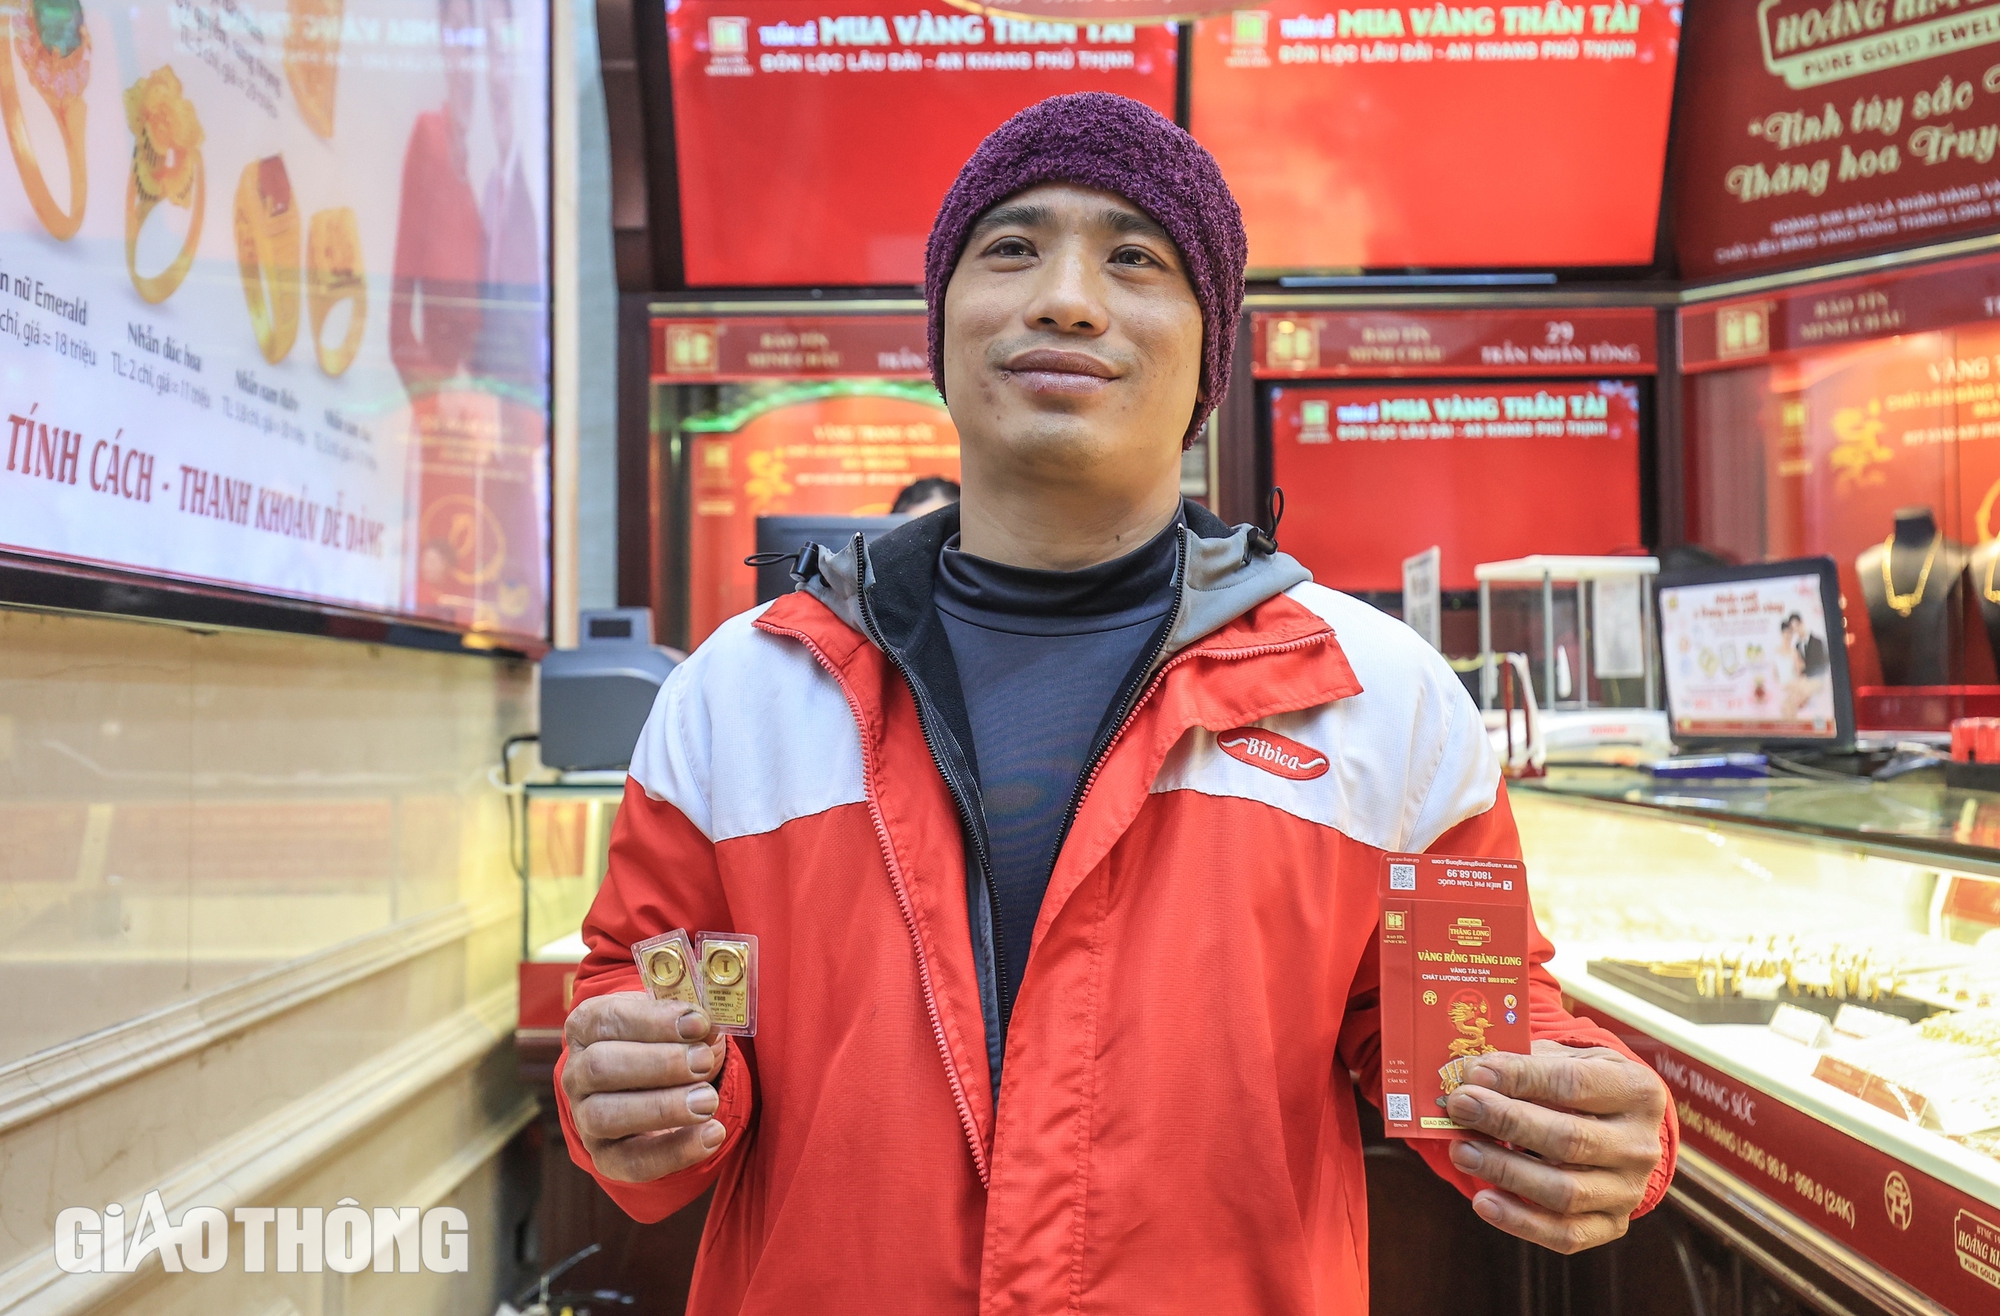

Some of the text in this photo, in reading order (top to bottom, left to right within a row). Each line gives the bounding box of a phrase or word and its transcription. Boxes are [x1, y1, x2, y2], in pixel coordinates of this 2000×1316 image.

[818, 15, 892, 46] MUA
[892, 9, 985, 46] VÀNG
[1337, 0, 1641, 38] MUA VÀNG THẦN TÀI
[1803, 14, 2000, 76] PURE GOLD JEWEL
[1837, 144, 1901, 183] hoa
[1907, 122, 2000, 166] Truy
[14, 275, 87, 326] nữ Emerald
[23, 320, 40, 347] giá
[54, 330, 67, 356] 18
[70, 340, 96, 369] triệu
[127, 321, 160, 354] Nhẫn
[184, 344, 202, 373] hoa
[1545, 320, 1575, 345] 29
[128, 359, 136, 381] 2
[1380, 390, 1608, 422] MUA VÀNG THẦN TÀI
[6, 402, 82, 486] TÍNH
[89, 428, 154, 503] CÁCH
[179, 464, 252, 526] THANH
[1246, 737, 1299, 770] Bibica
[1446, 869, 1492, 879] 1800.68.99
[1449, 928, 1472, 936] THĂNG
[1417, 949, 1522, 967] VÀNG RỒNG THĂNG LONG
[1450, 966, 1467, 974] VÀNG
[1467, 967, 1478, 975] TÀI
[1655, 1050, 1757, 1127] VÀNG TRANG SỨC
[1736, 1136, 1766, 1171] LONG
[1824, 1188, 1855, 1230] (24K)
[1980, 1267, 1996, 1282] GOLD
[1989, 1246, 2000, 1269] KI
